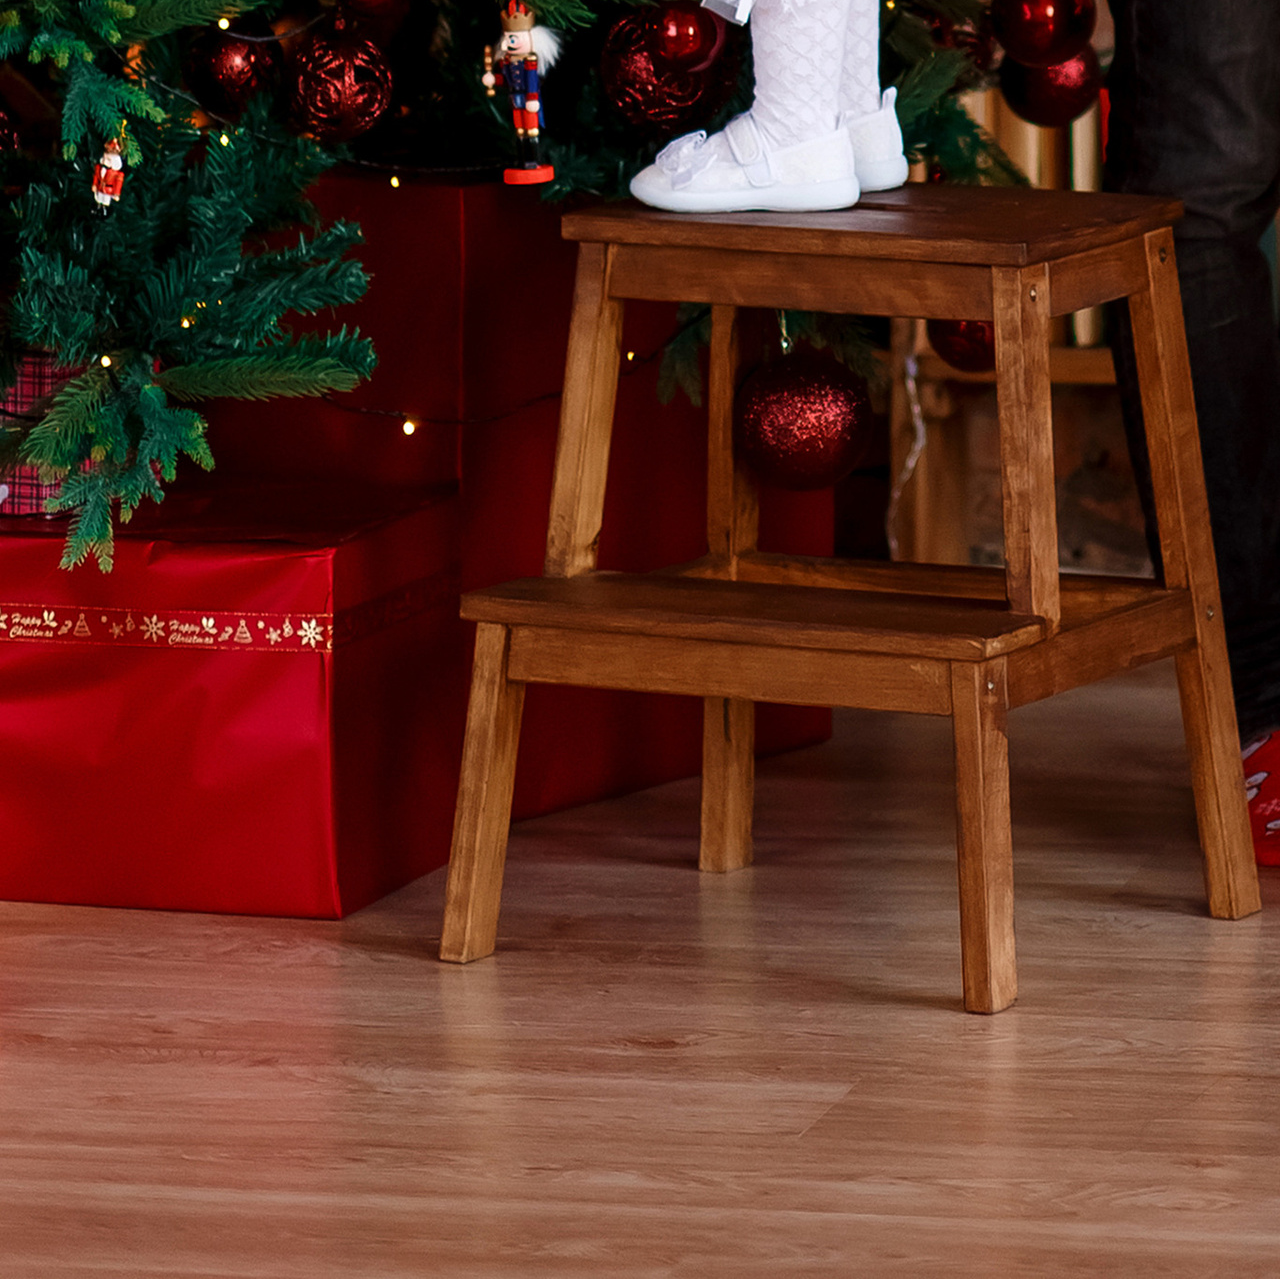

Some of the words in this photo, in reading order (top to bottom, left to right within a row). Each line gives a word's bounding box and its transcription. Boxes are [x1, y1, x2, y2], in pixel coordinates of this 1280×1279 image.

[11, 612, 42, 626] Happy
[169, 619, 200, 633] Happy
[9, 626, 54, 638] Christmas
[168, 632, 214, 646] Christmas
